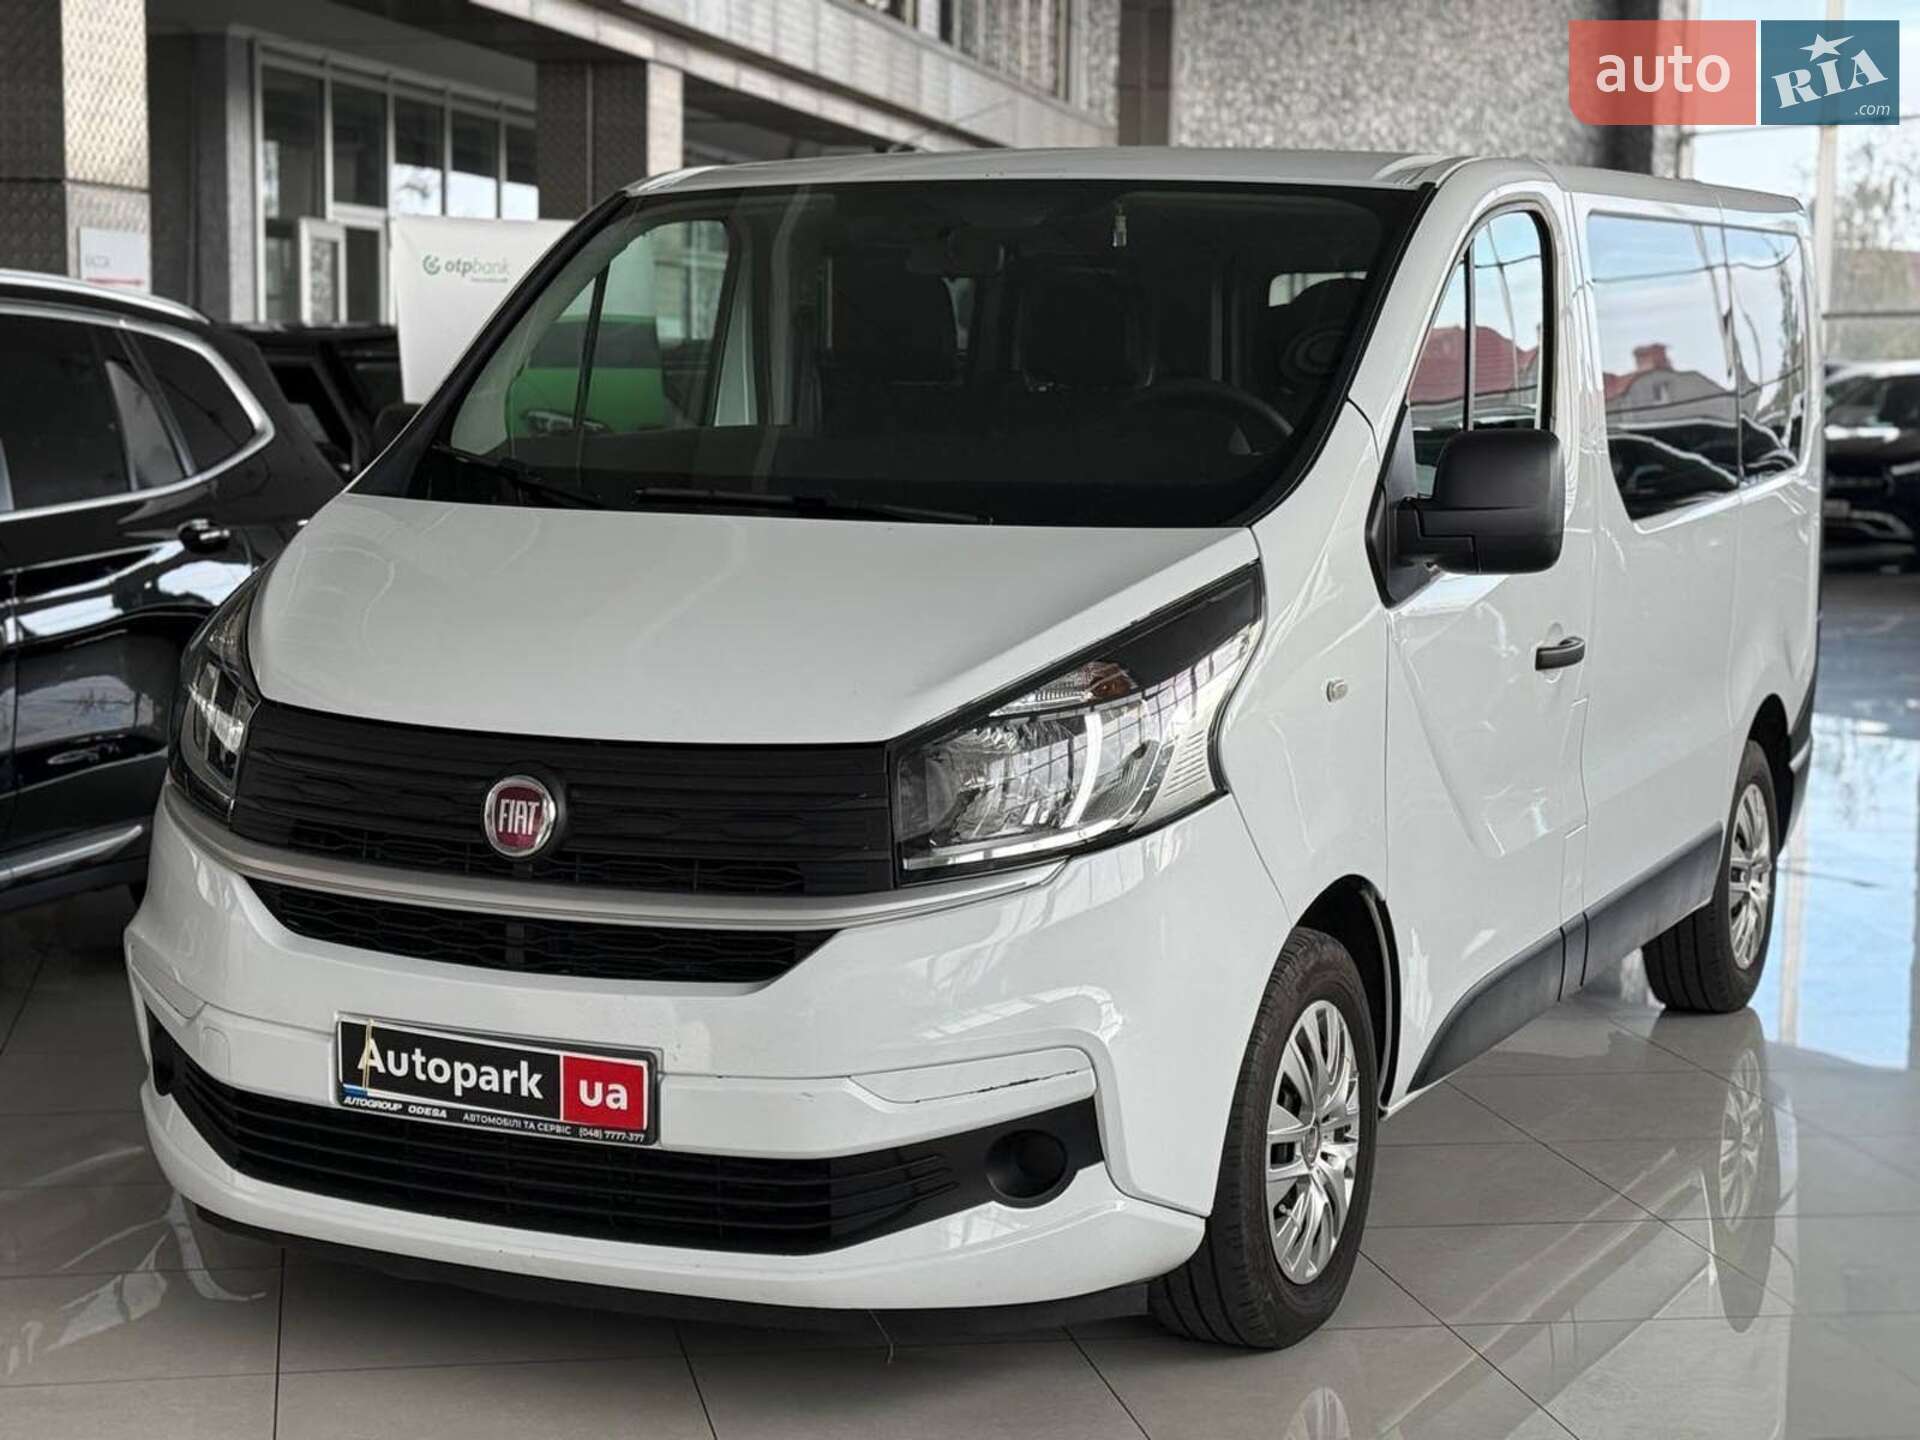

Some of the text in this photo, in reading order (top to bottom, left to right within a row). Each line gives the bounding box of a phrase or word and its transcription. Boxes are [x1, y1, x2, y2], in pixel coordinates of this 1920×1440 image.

[498, 798, 540, 835] FIAT
[357, 1037, 629, 1111] Autopark ua
[343, 1096, 402, 1112] AUTOGROUP
